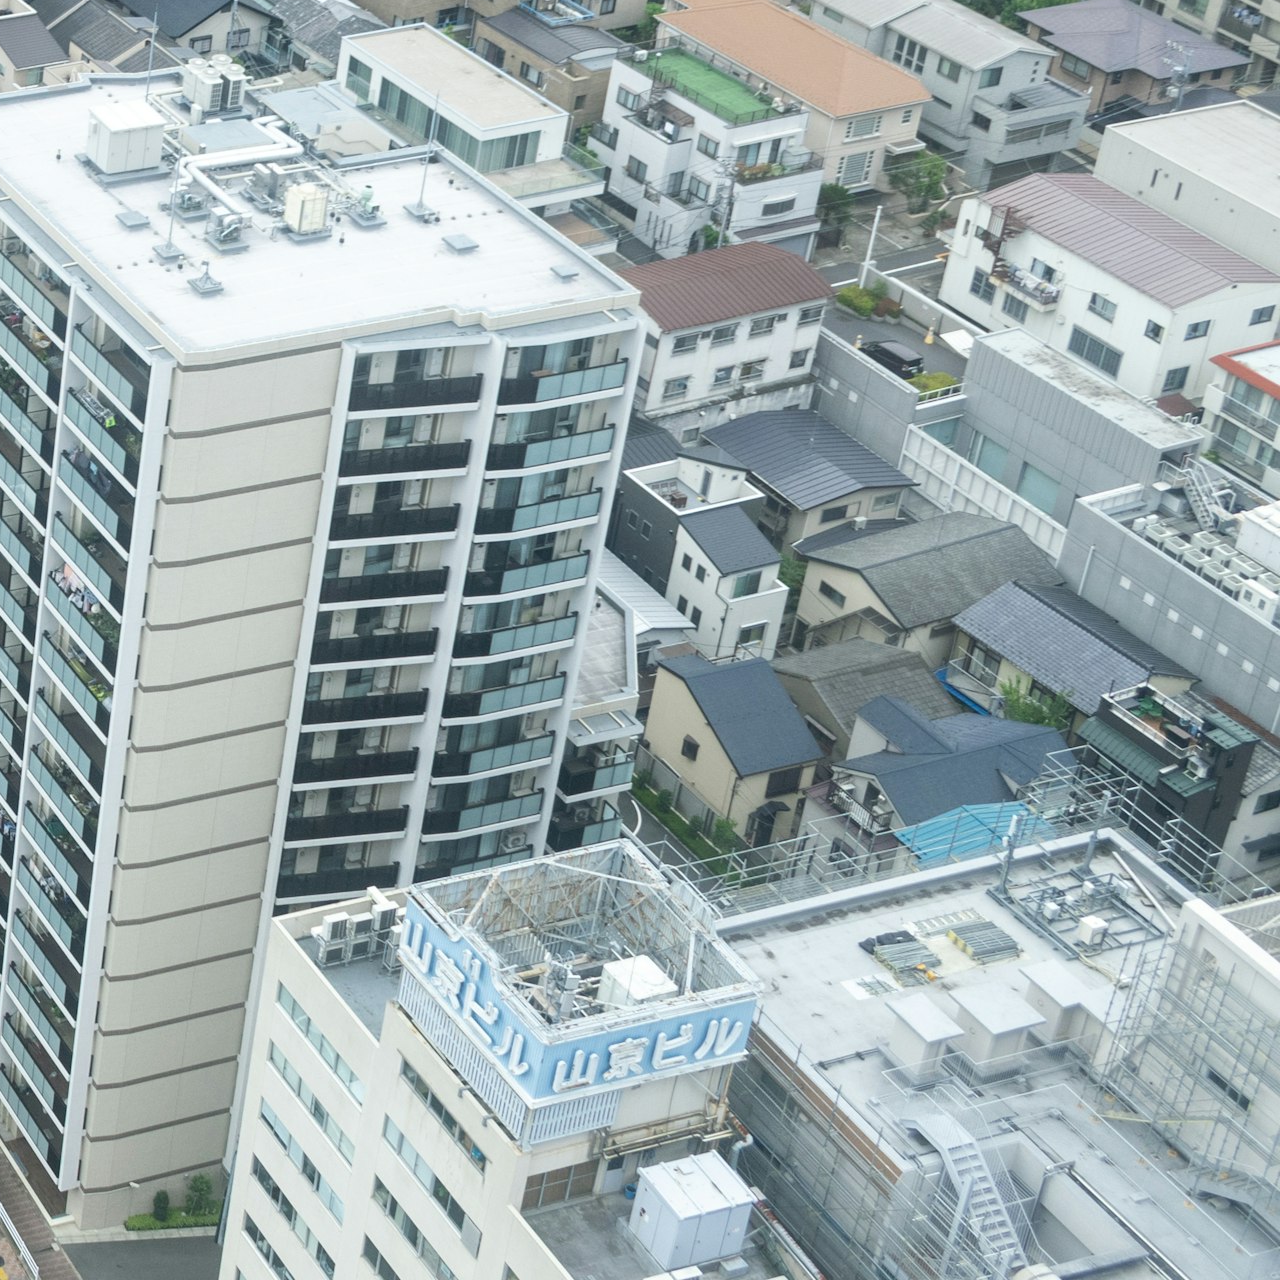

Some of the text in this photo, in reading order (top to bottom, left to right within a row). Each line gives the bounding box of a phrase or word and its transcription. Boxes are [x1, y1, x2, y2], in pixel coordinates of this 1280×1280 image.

[399, 919, 529, 1076] 山京ビル
[552, 1017, 744, 1093] 山京ビル
